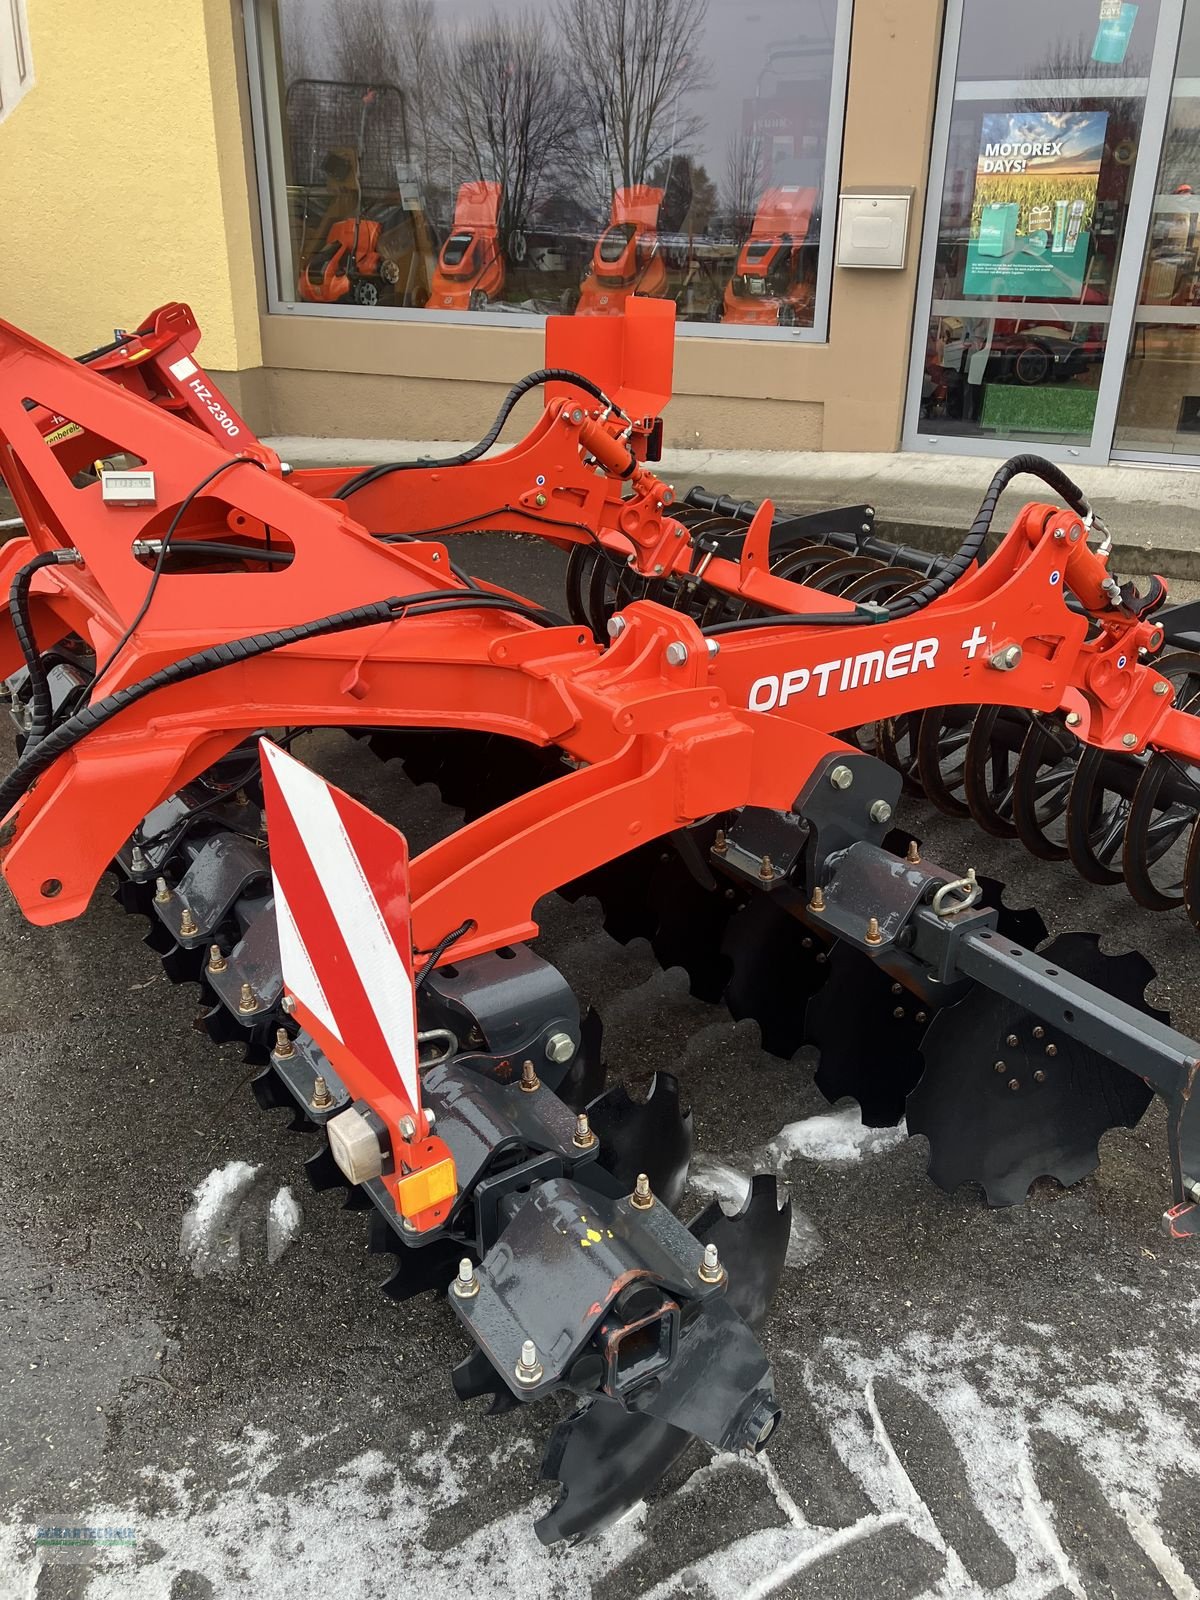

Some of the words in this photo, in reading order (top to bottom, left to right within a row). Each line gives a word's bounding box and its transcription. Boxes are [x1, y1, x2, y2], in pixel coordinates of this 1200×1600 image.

[983, 159, 1027, 173] DAYS!
[985, 142, 1062, 157] MOTOREX
[189, 379, 240, 436] HZ-2300
[748, 637, 939, 712] OPTIMER
